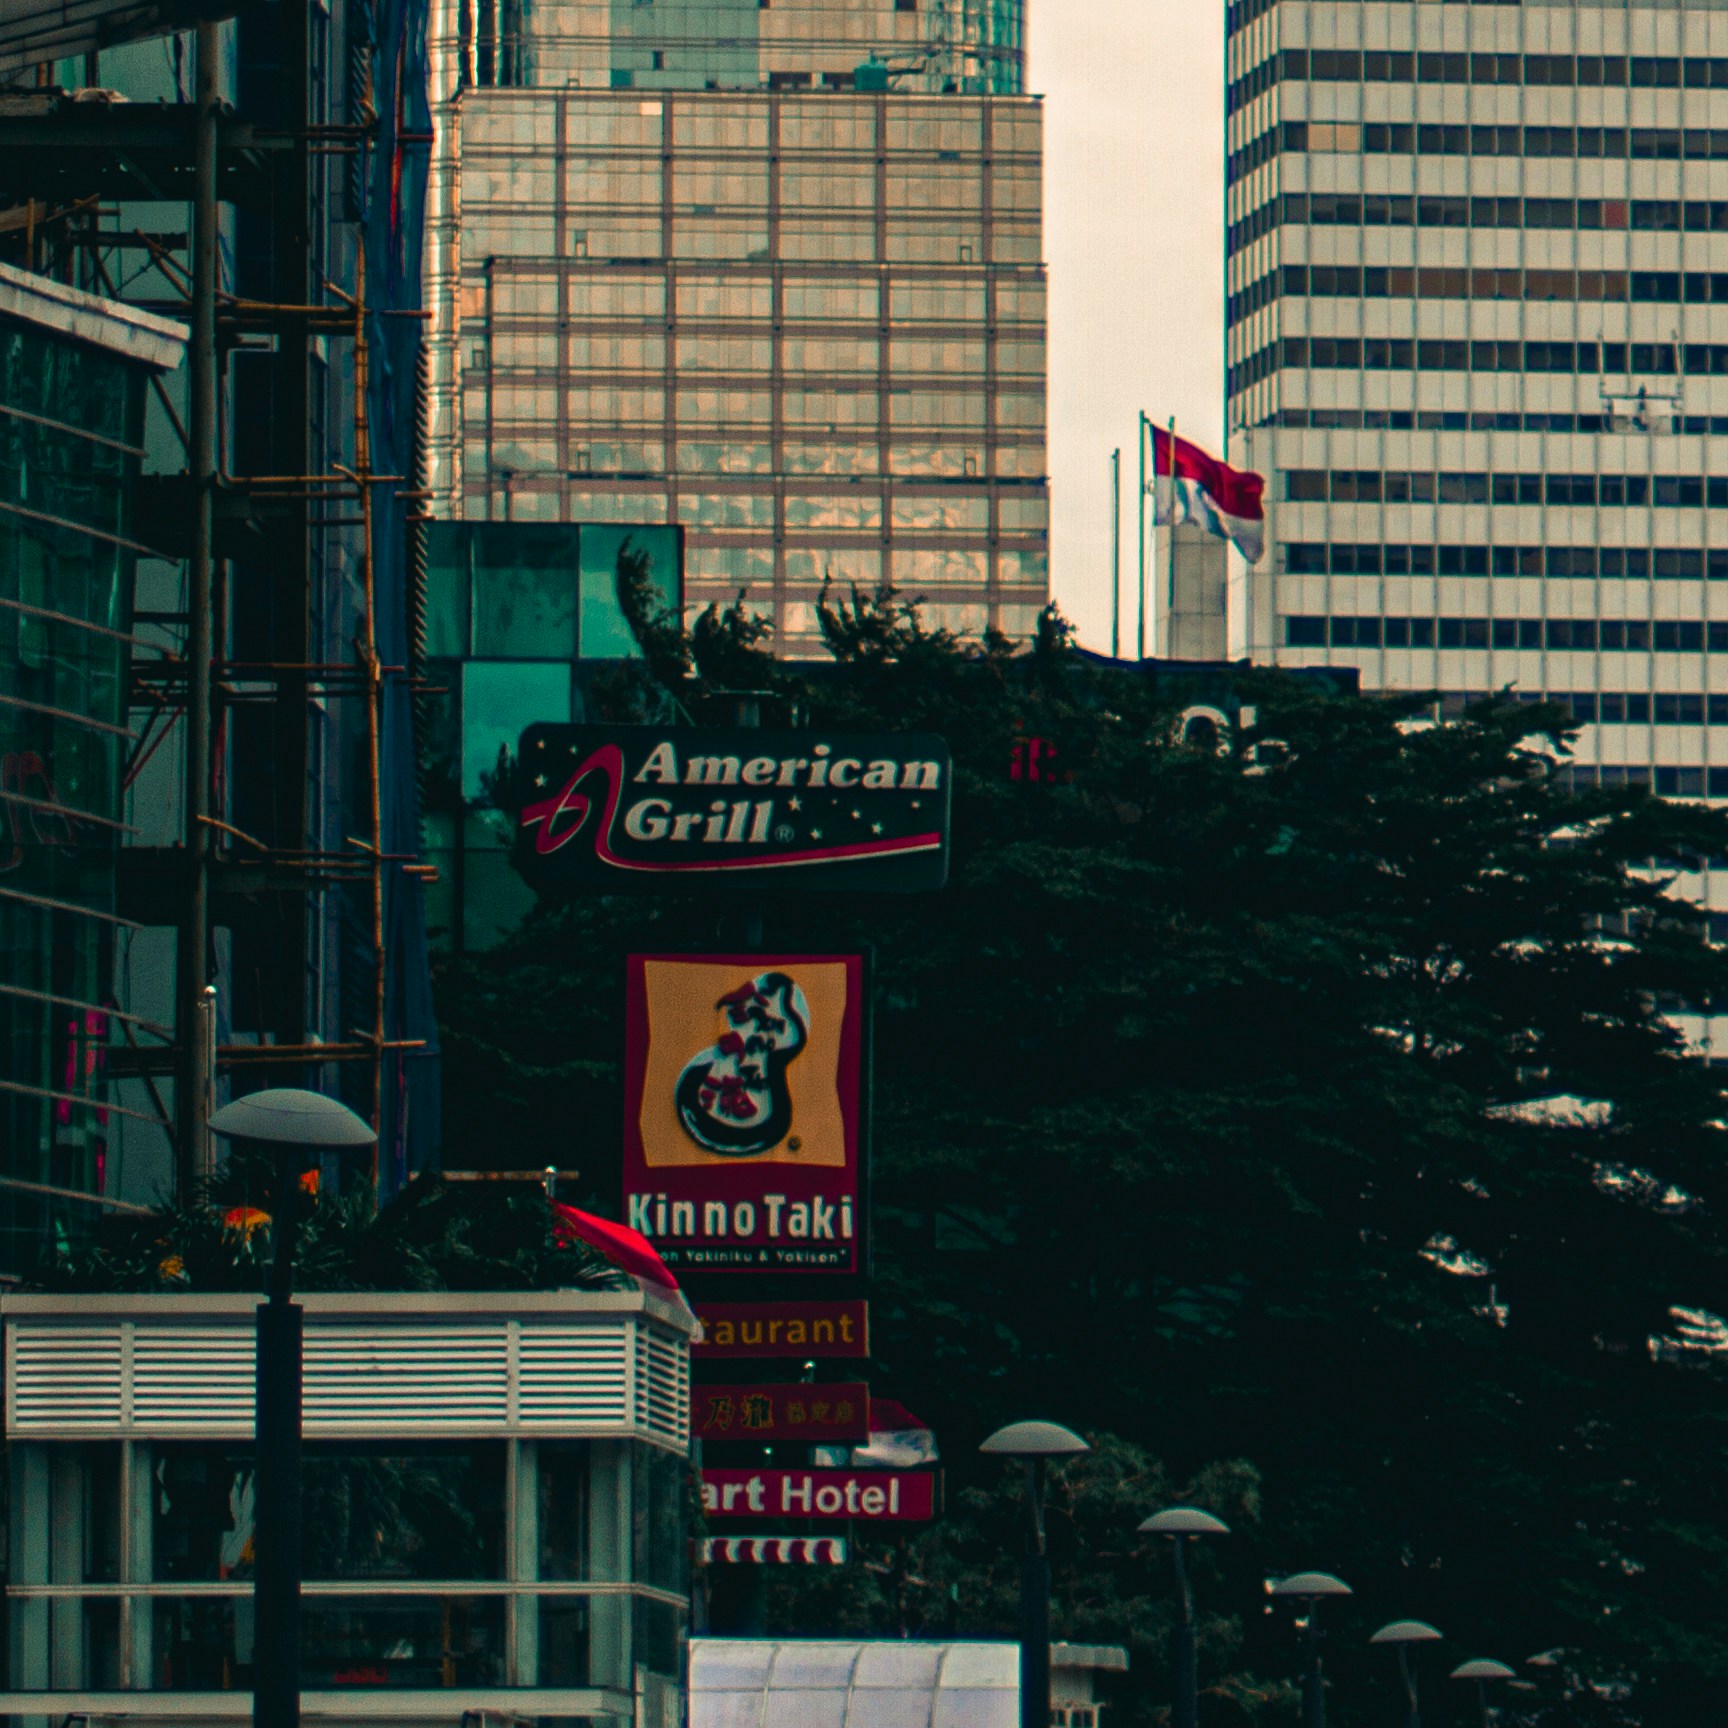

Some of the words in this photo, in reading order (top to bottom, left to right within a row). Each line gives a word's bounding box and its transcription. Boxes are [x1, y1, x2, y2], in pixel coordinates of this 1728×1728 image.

[633, 741, 941, 790] American
[624, 798, 774, 842] Grill
[686, 1249, 752, 1262] Yakiniku
[781, 1475, 900, 1515] Hotel
